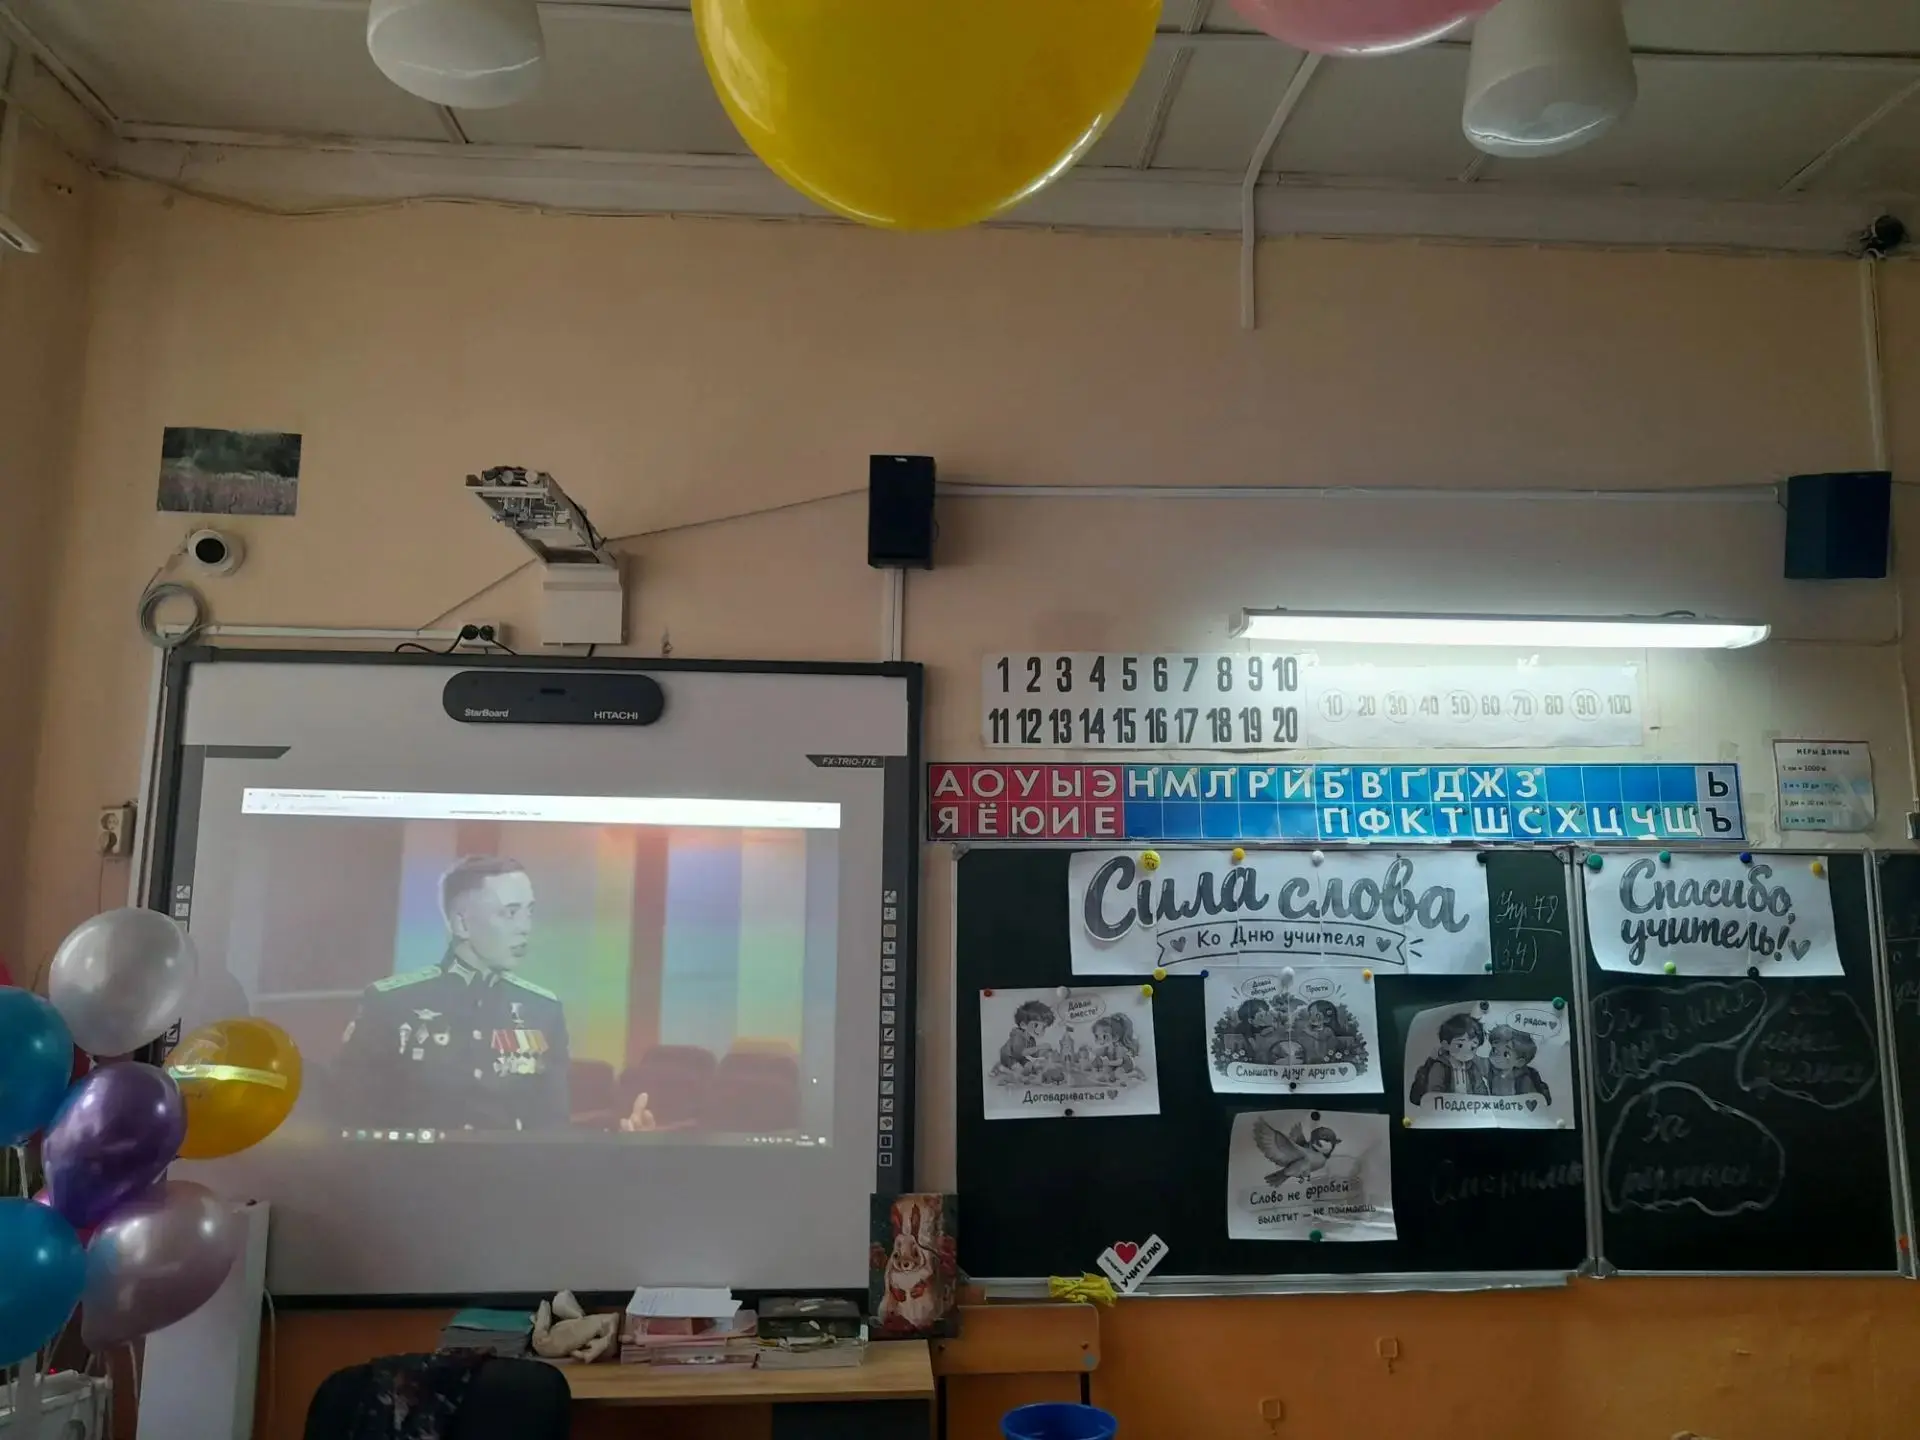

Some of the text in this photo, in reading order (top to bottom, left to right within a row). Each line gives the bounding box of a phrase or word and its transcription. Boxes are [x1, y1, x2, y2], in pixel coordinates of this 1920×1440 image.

[997, 657, 1298, 692] 1 2 3 4 5 6 7 8 9 10
[464, 708, 509, 718] StarBoard
[593, 711, 639, 720] HITACHI
[1326, 694, 1632, 716] 10 20 30 40 50 60 70 80 90 100
[988, 707, 1298, 743] 11 12 13 14 15 16 17 18 19 20
[822, 757, 877, 766] FX-TRIO-77E
[934, 767, 1728, 802] А О У Ы Э Н М Л Р Й Б В Г Д Ж З Ь
[937, 803, 1732, 836] Я Ё Ю И Е П Ф К Т Ш С Х Ц Ч Щ Ъ
[1278, 858, 1470, 933] слова
[1620, 858, 1796, 924] Спасибо,
[1197, 926, 1365, 948] Ко Дню учителя
[1621, 912, 1791, 966] учитель!
[1305, 984, 1328, 994] Прости
[1068, 1000, 1092, 1011] Давай
[1514, 1014, 1547, 1027] Я рядом
[1236, 1065, 1336, 1080] Слышать друг друга
[1022, 1090, 1105, 1105] Договариваться
[1434, 1096, 1524, 1114] Поддерживать
[1250, 1180, 1349, 1205] Слово не воробей
[1258, 1212, 1299, 1225] вылетит
[1313, 1206, 1324, 1216] не
[1328, 1204, 1376, 1216] поймаешь
[1121, 1241, 1162, 1288] УЧИТЕЛЮ
